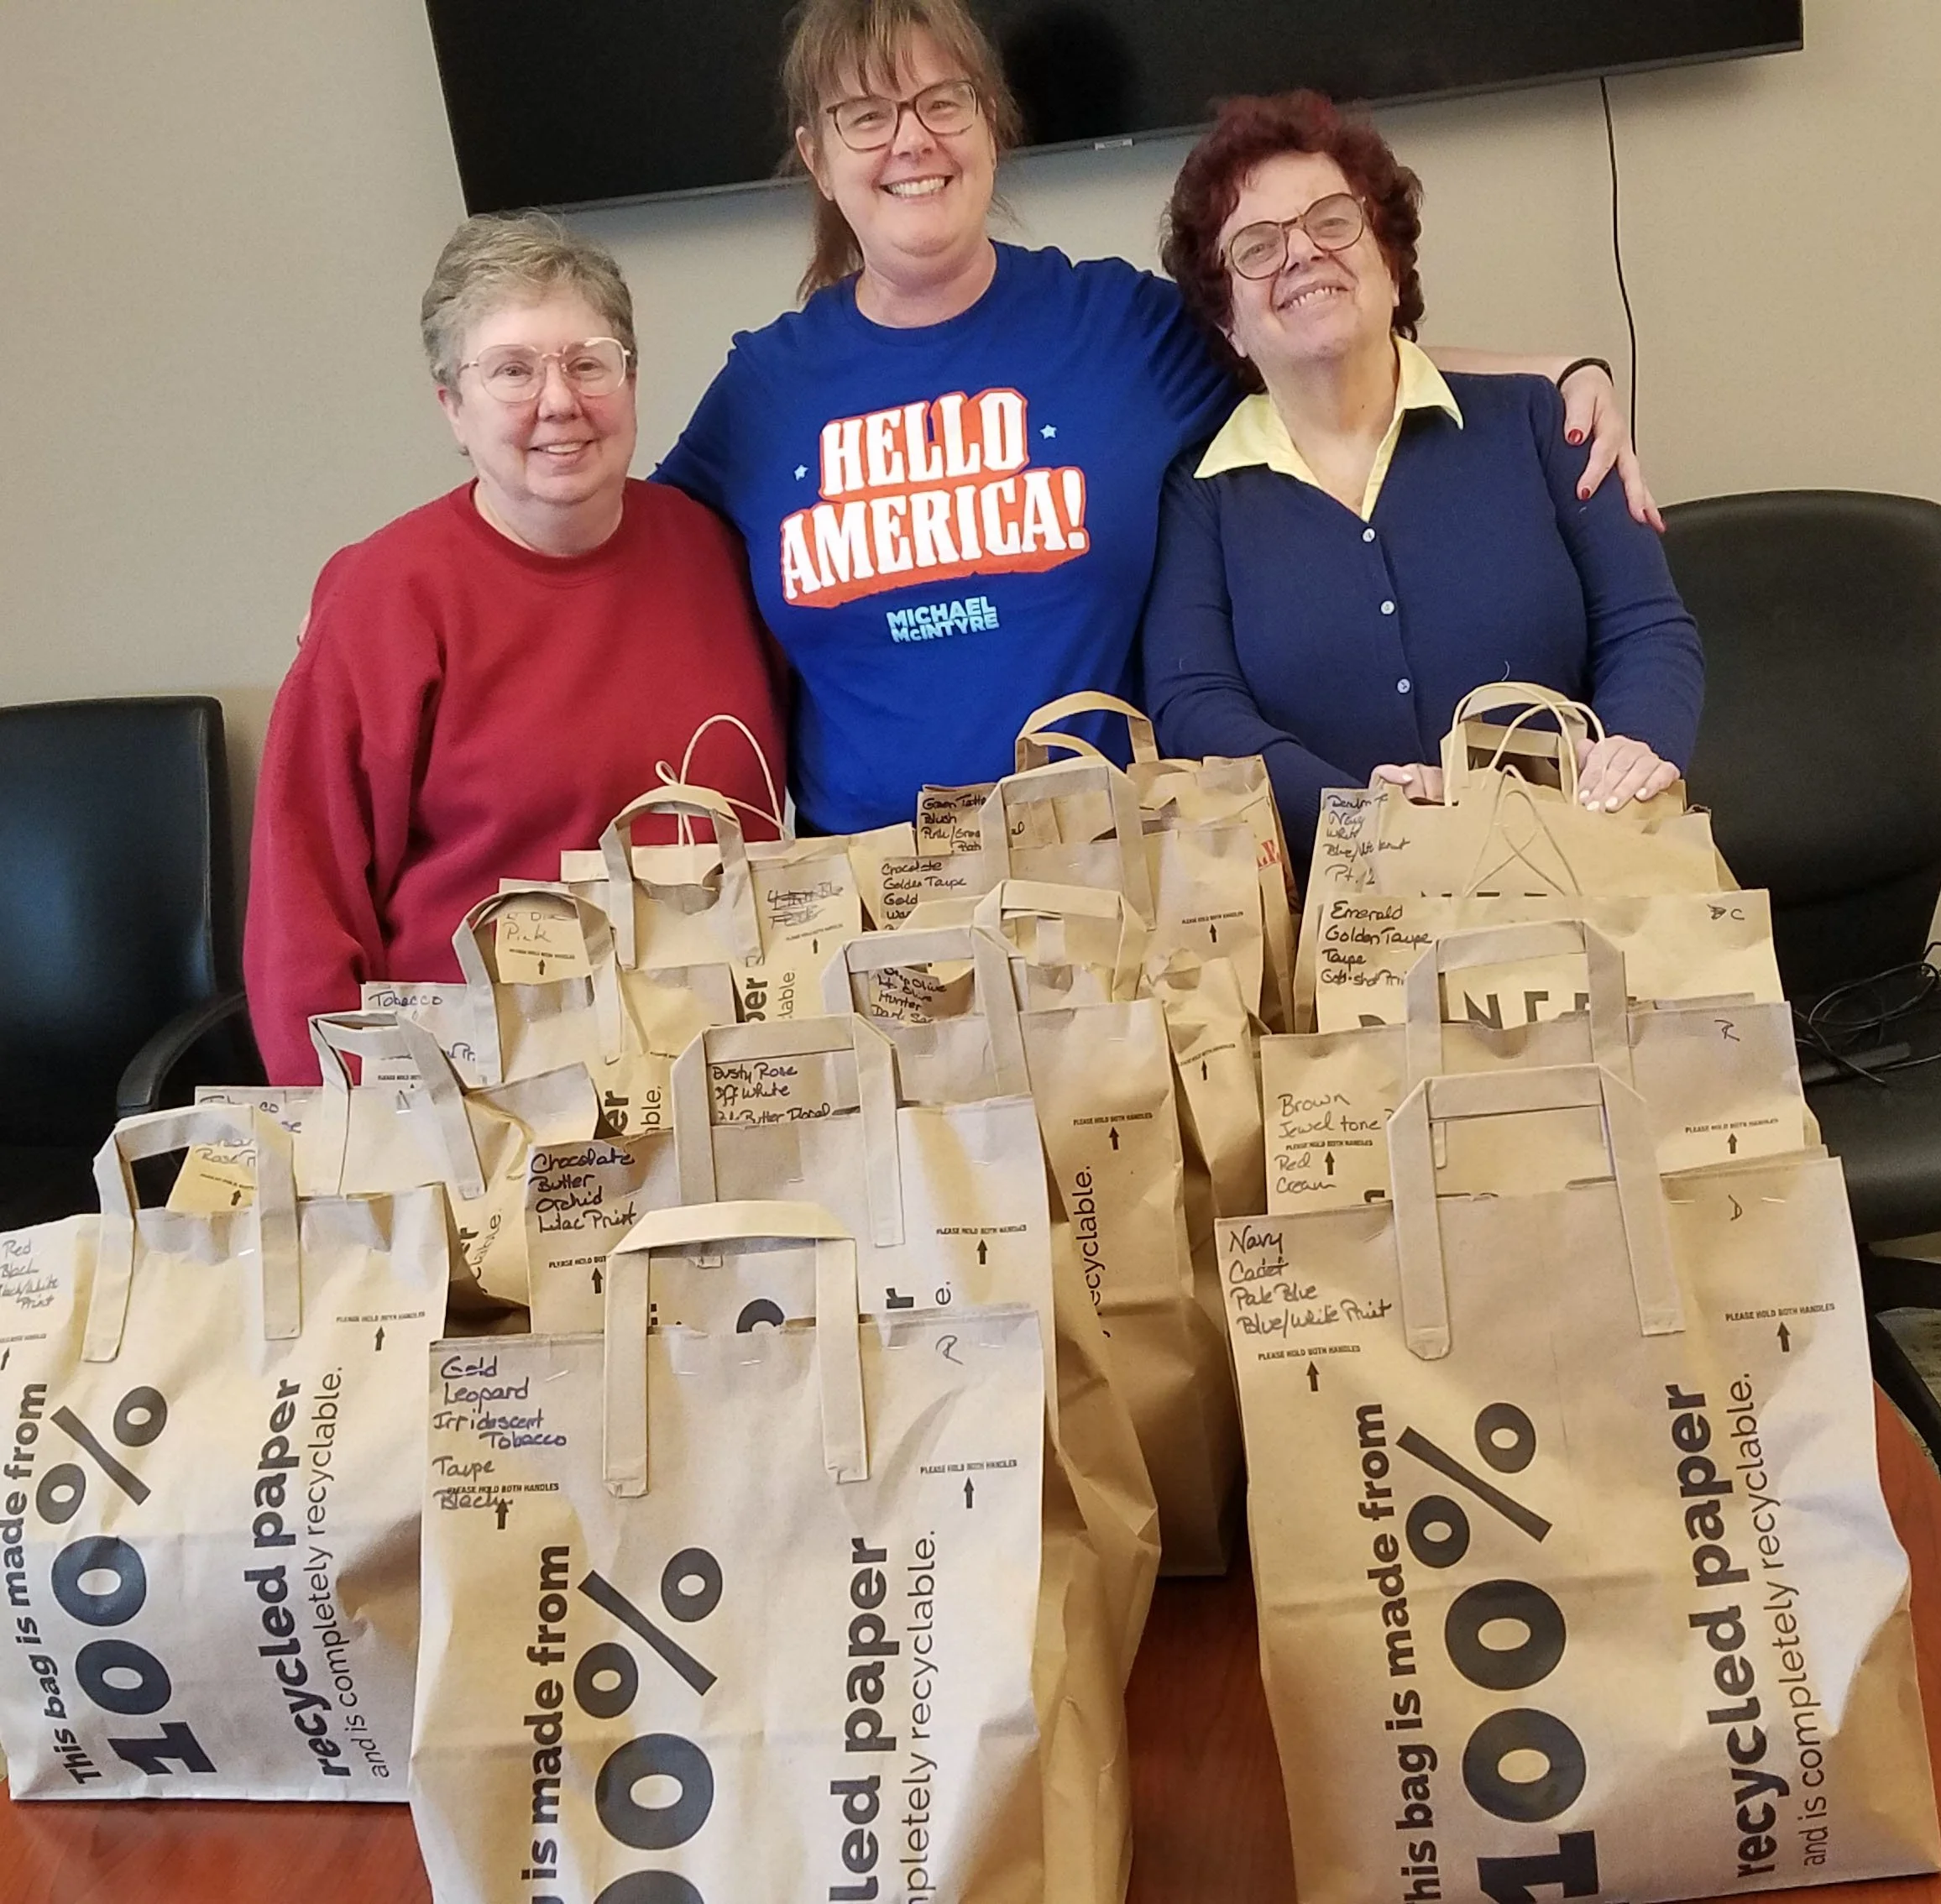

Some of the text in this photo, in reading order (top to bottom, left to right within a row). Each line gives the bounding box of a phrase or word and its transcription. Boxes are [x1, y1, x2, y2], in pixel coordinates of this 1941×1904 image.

[821, 390, 1028, 497] HELLO
[782, 468, 1086, 600] AMERICA!
[886, 596, 997, 630] MICHAEL
[891, 613, 999, 644] McINTYRE
[883, 876, 967, 891] Golden Taupe
[883, 892, 918, 906] Gold
[1331, 901, 1403, 921] Emerald
[503, 921, 552, 943] Pink
[1325, 925, 1433, 951] Golden Taupe
[1321, 949, 1367, 972] Taupe
[369, 990, 443, 1007] Tobacco
[879, 990, 923, 1011] Hunter
[713, 1061, 798, 1084] Dusty Rose
[742, 1081, 791, 1101] White
[1278, 1093, 1351, 1117] Brown
[1278, 1111, 1382, 1139] Jewel tone
[531, 1148, 636, 1174] Chocolate
[1274, 1151, 1311, 1172] Red
[528, 1174, 595, 1193] Butter
[1276, 1176, 1337, 1195] Cream
[536, 1185, 603, 1214] Orchid
[538, 1201, 637, 1233] Lilac Print
[3, 1238, 32, 1258] Red
[1072, 1165, 1106, 1316] ecyclable.
[1229, 1225, 1284, 1254] Navy
[1273, 1282, 1319, 1303] Blue
[1340, 1298, 1393, 1323] Print
[1724, 1302, 1836, 1322] PLEASE HOLD BOTH HANDLES
[440, 1355, 498, 1380] Gold
[1258, 1345, 1361, 1361] PLEASE HOLD BOTH HANDLES
[443, 1377, 529, 1415] Leopard
[3, 1383, 47, 1479] from
[479, 1431, 568, 1450] Tobacco
[432, 1456, 495, 1483] Taupe
[0, 1488, 32, 1608] made
[35, 1385, 217, 1777] 100%
[243, 1378, 352, 1779] recycled paper
[306, 1366, 390, 1779] and is completely recyclable.
[526, 1546, 570, 1666] from
[1726, 1373, 1829, 1867] and is completely recyclable.
[17, 1615, 42, 1645] is
[1665, 1384, 1791, 1879] recycled paper
[845, 1537, 901, 1753] paper
[1358, 1403, 1442, 1904] his bag is made from
[1395, 1402, 1599, 1904] 100%
[28, 1653, 67, 1718] bag
[899, 1530, 939, 1904] pletely recyclable.
[53, 1728, 102, 1785] This
[523, 1679, 564, 1825] made
[521, 1838, 557, 1880] is
